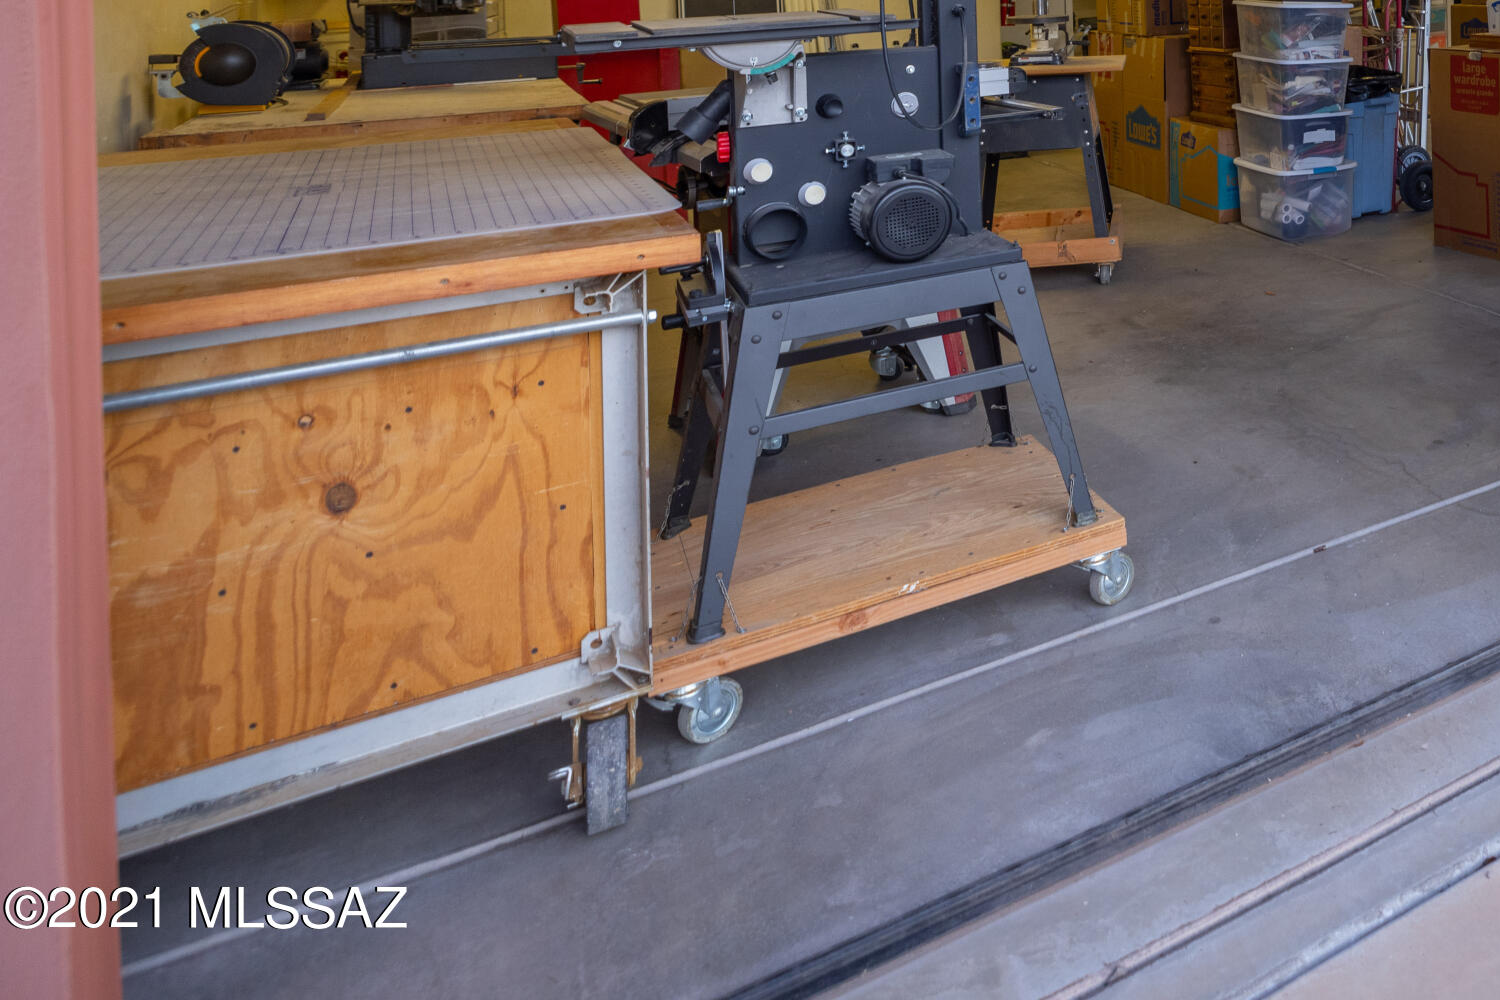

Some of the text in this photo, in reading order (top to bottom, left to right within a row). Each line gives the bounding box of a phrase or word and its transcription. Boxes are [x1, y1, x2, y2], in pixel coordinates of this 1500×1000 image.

[1462, 61, 1487, 76] large
[1453, 75, 1496, 88] wardrobe
[1128, 117, 1158, 145] LOWE'S
